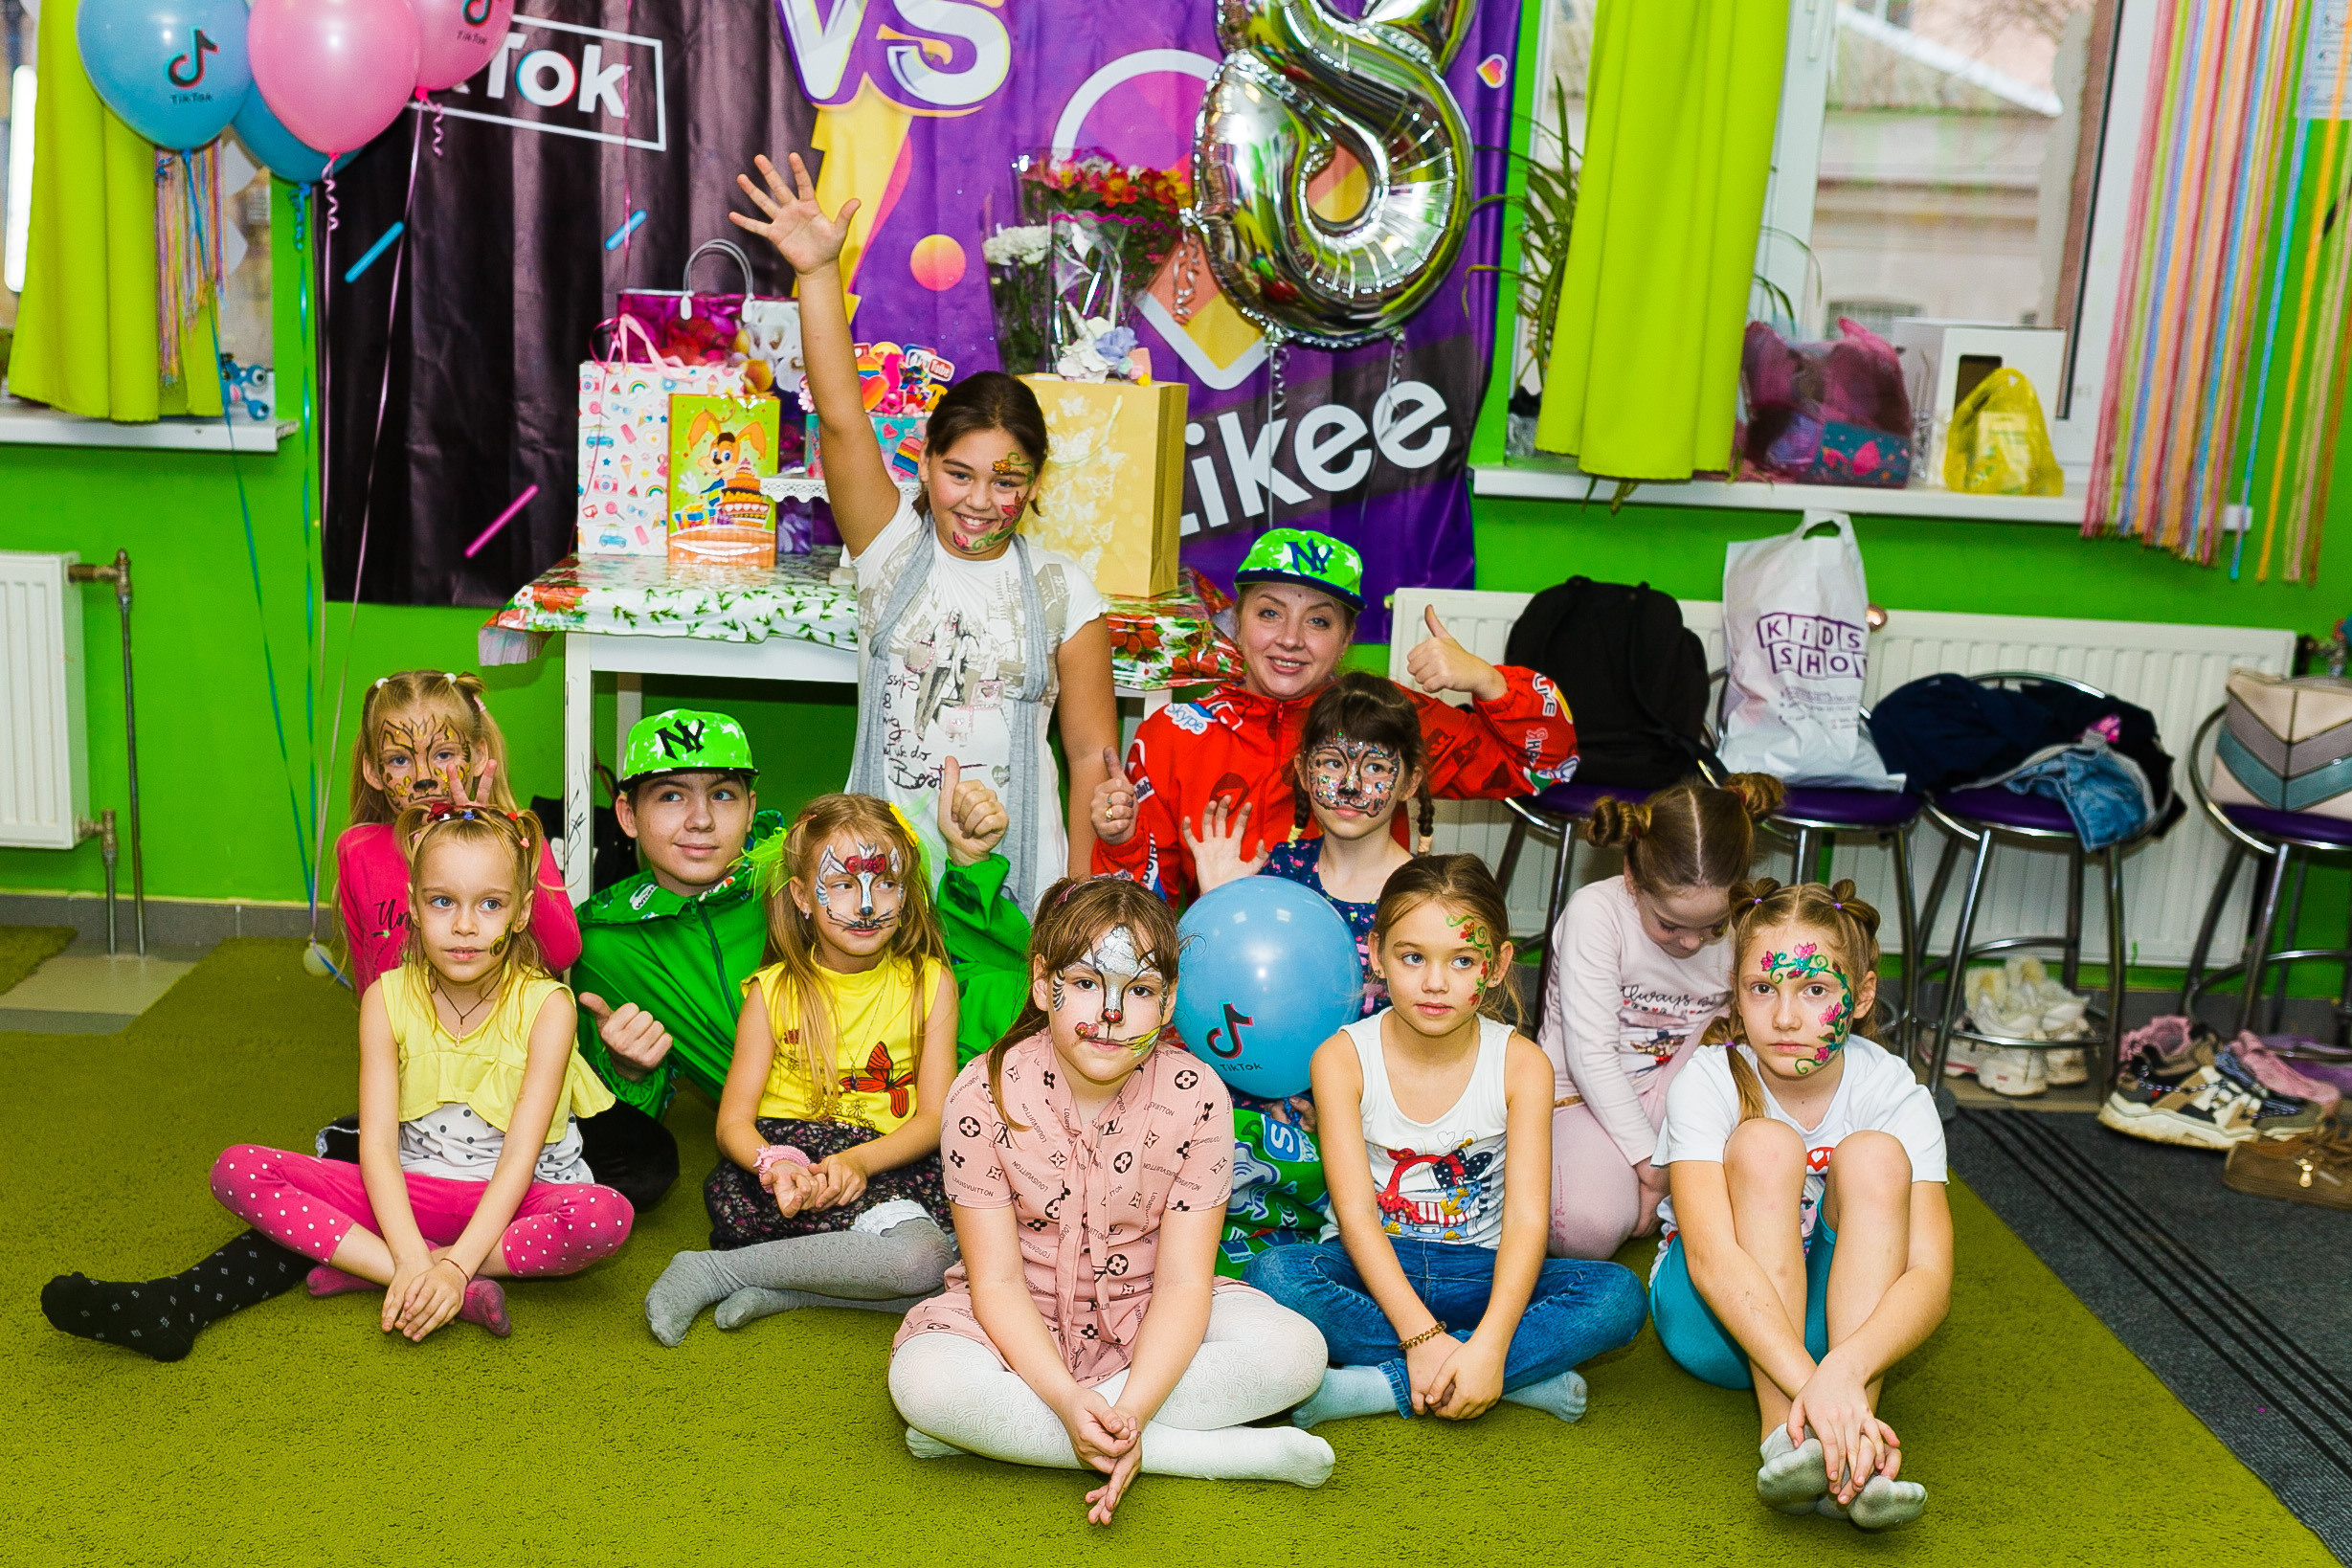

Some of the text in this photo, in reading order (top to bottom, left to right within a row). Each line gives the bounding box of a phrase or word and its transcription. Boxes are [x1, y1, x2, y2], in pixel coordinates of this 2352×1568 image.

[456, 33, 628, 120] Tok
[781, 0, 1009, 107] VS
[1180, 381, 1451, 538] ikee
[1781, 647, 1868, 674] SHO
[1166, 703, 1204, 732] Skype
[1220, 1062, 1263, 1073] TikTok
